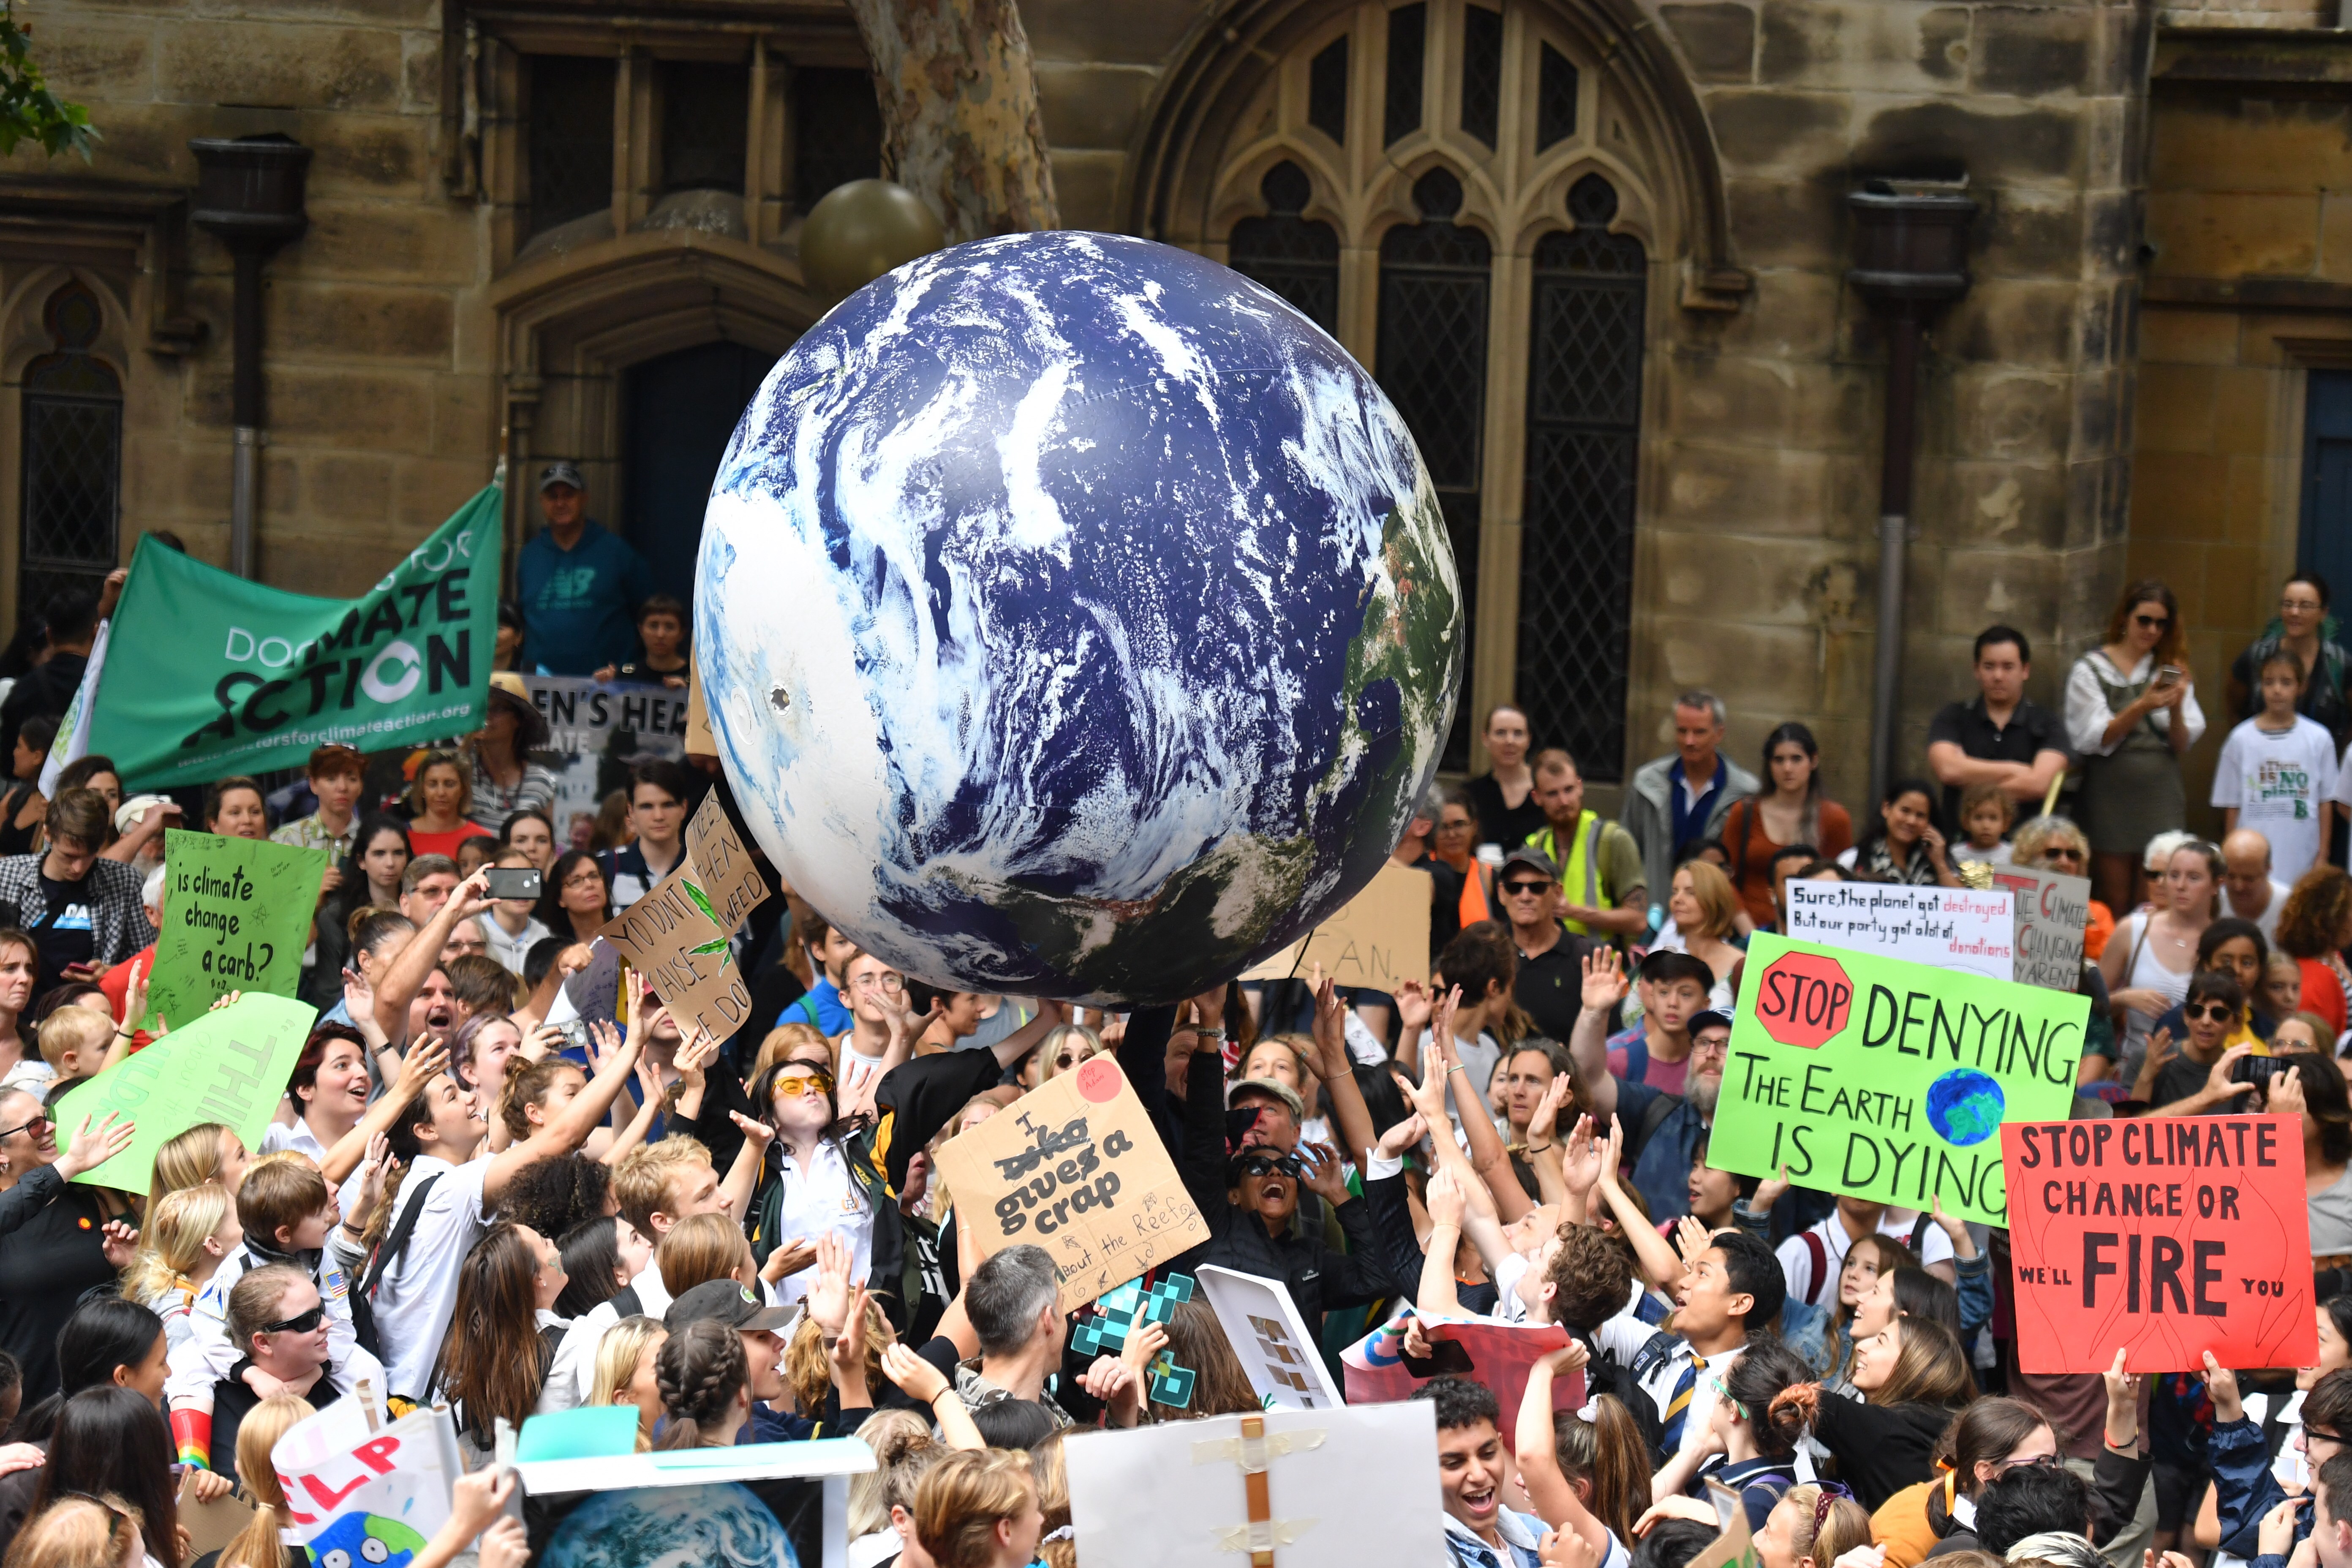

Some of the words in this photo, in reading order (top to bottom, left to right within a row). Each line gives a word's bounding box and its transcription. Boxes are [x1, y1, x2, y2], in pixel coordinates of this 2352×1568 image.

[689, 787, 722, 850] TREES
[178, 861, 189, 893] is
[193, 865, 253, 901] climate
[185, 900, 240, 946] change
[1794, 911, 1817, 928] But
[1820, 919, 1843, 930] our
[1848, 917, 1886, 942] party
[1891, 920, 1911, 944] got
[1870, 890, 1915, 916] planet
[1918, 894, 1940, 920] got
[2041, 883, 2088, 929] CLIMATE
[610, 917, 654, 954] YO
[1949, 936, 2010, 958] donations
[201, 950, 212, 973] a
[218, 942, 273, 982] carb?
[647, 946, 707, 1004] CAUSE
[1761, 969, 1850, 1030] STOP
[1862, 984, 2080, 1088] DENYING
[1015, 1111, 1038, 1137] I
[1102, 1130, 1133, 1159] a
[2020, 1123, 2112, 1169] STOP
[2122, 1123, 2277, 1168] CLIMATE
[1771, 1122, 1815, 1177] IS
[1841, 1132, 2009, 1224] DYING
[1034, 1171, 1121, 1235] crap
[2043, 1180, 2183, 1217] CHANGE
[2197, 1185, 2240, 1221] OR
[1101, 1234, 1127, 1256] the
[1132, 1196, 1179, 1236] Reef
[2017, 1265, 2072, 1286] WE'LL
[2082, 1231, 2228, 1318] FIRE
[2240, 1278, 2284, 1298] YOU
